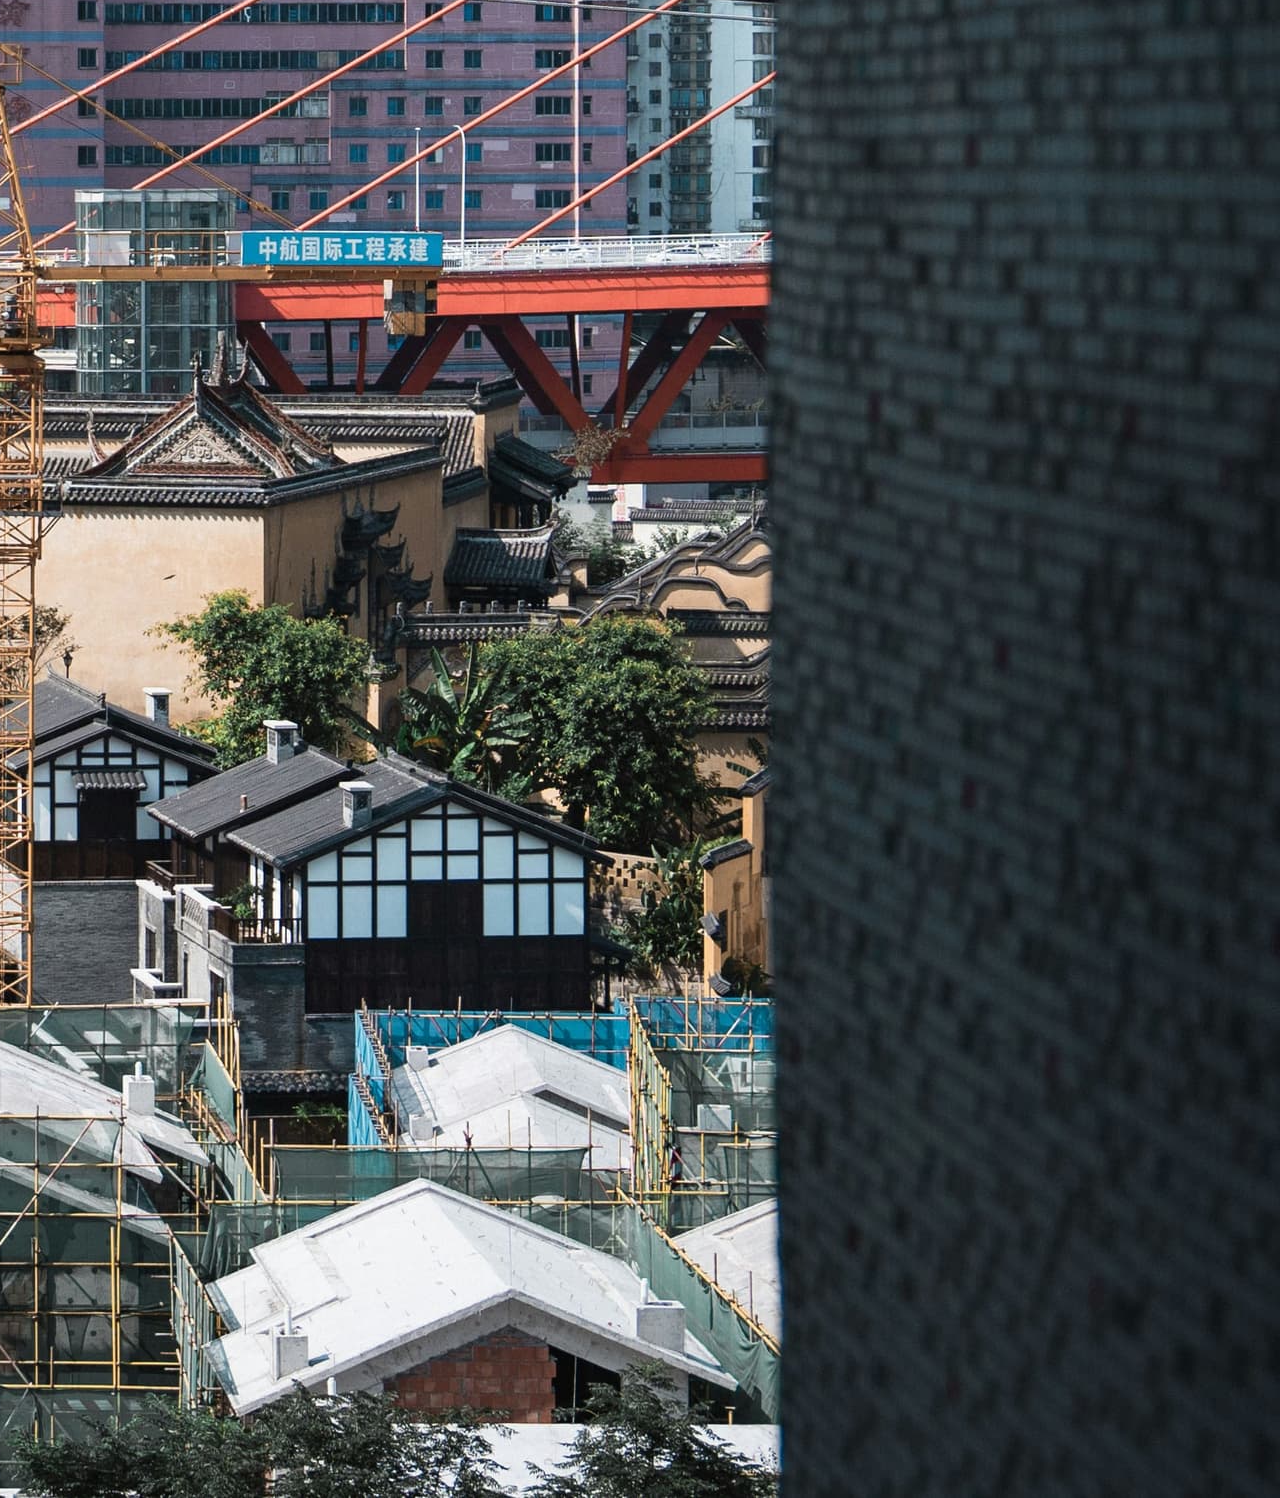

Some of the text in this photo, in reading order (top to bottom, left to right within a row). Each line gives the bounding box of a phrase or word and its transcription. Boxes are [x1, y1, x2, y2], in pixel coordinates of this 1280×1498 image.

[258, 236, 429, 262] 中航国际工程承建
